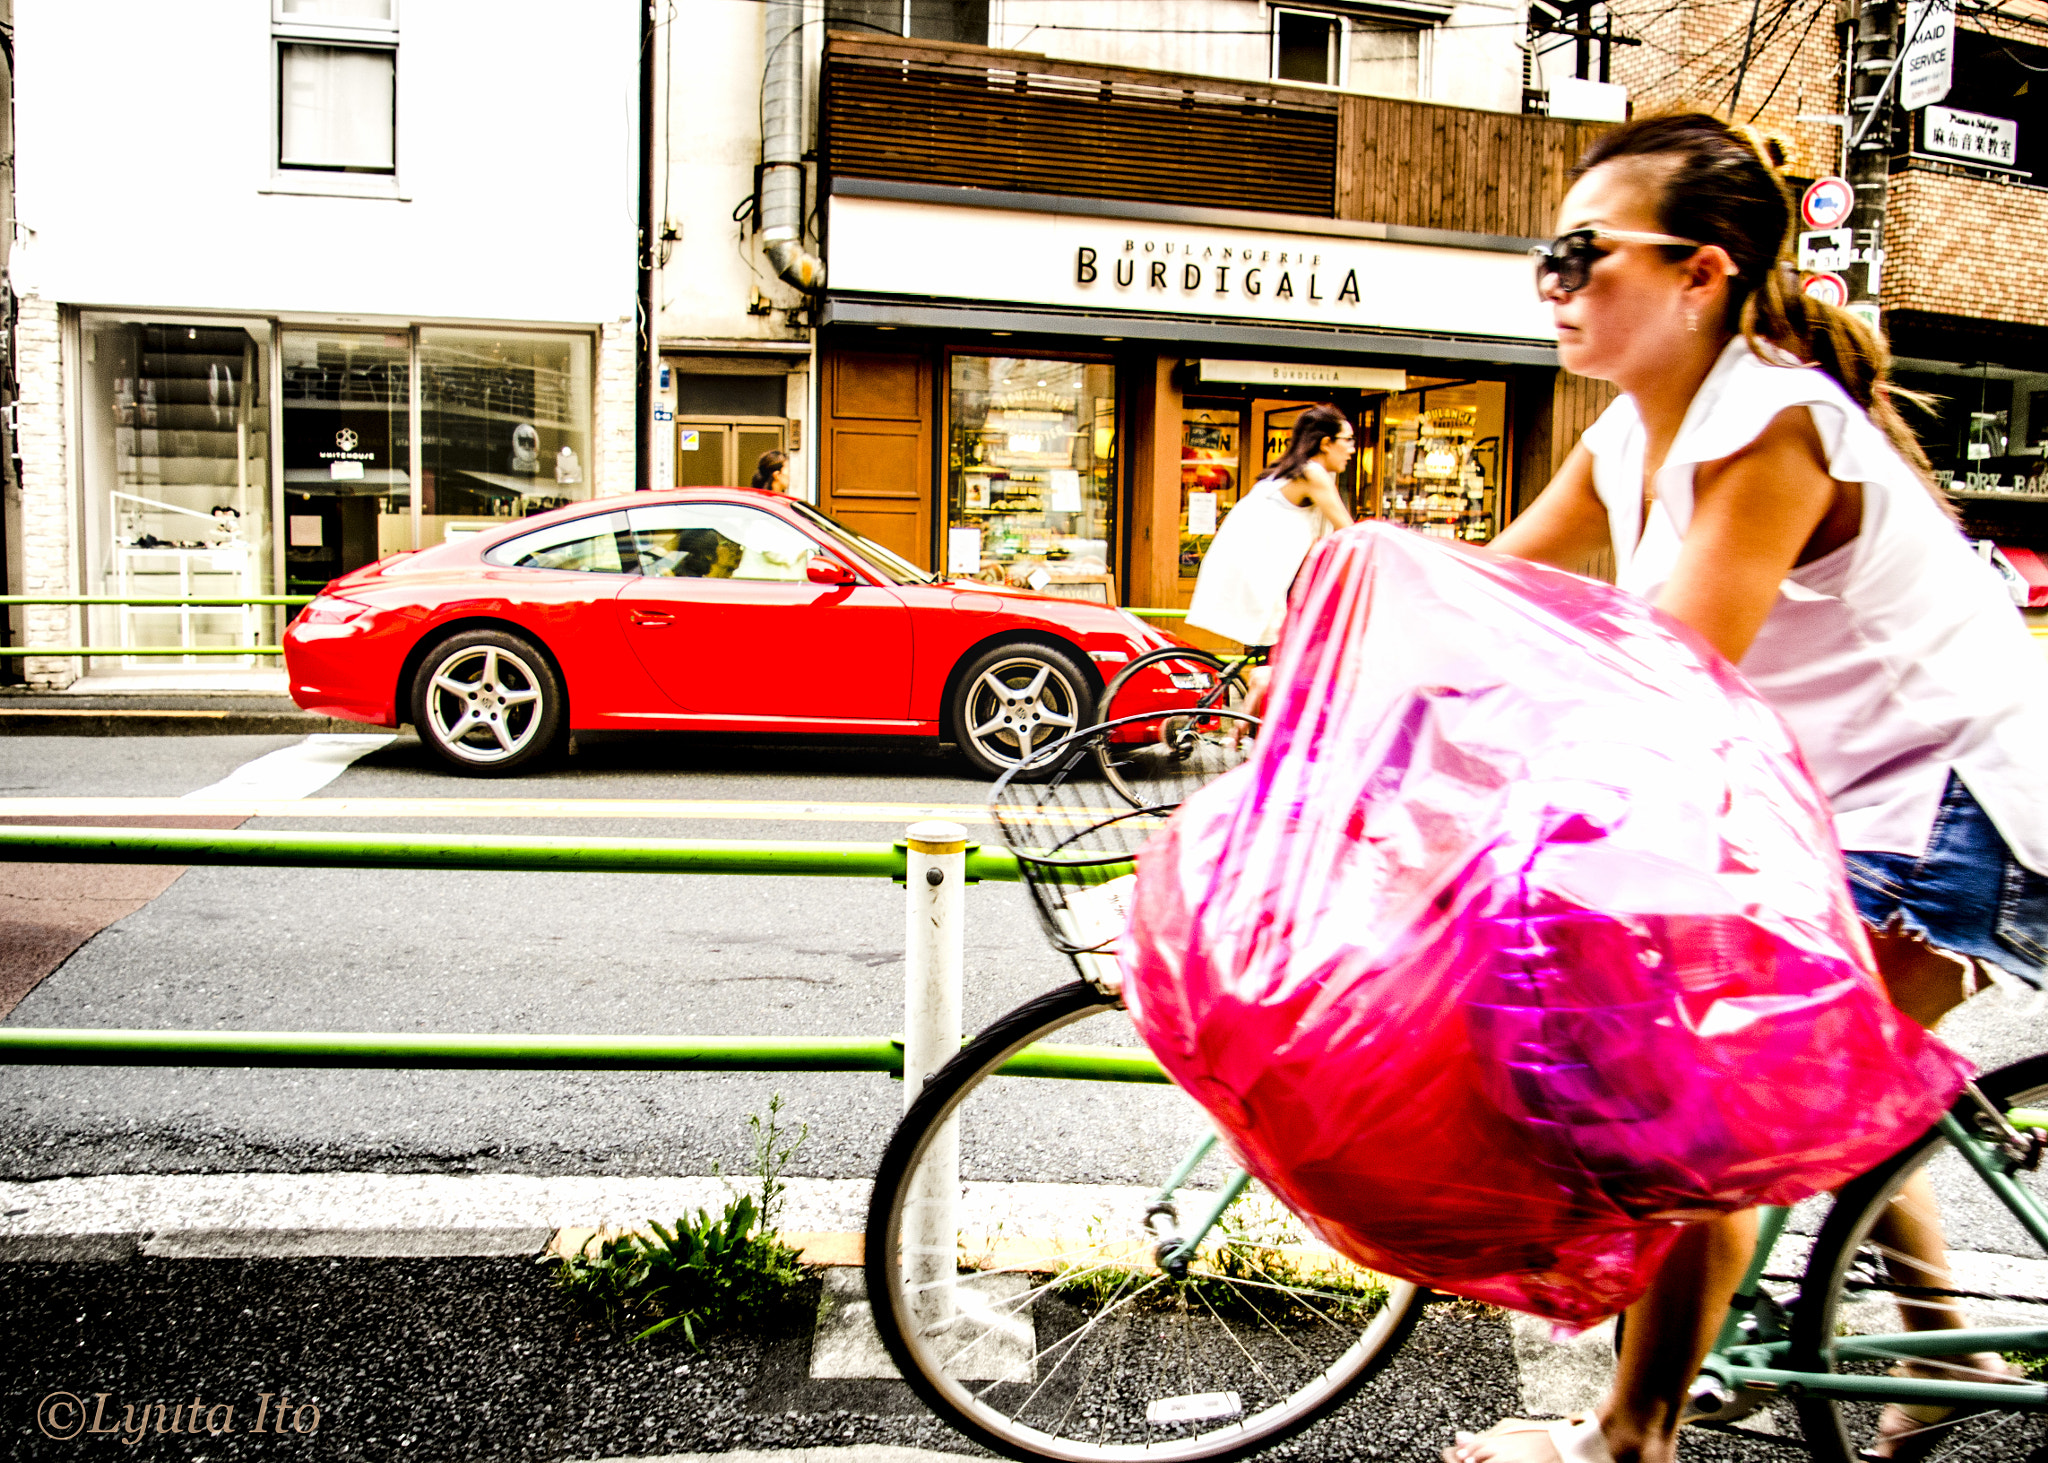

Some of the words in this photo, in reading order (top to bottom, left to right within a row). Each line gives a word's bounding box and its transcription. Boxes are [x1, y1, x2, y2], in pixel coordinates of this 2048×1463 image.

[1913, 25, 1945, 46] MAID
[1909, 48, 1947, 72] SERVICE
[1125, 239, 1322, 266] BOULANGERIE
[1077, 246, 1361, 303] BURDIGALA
[1273, 368, 1339, 381] BURDIGALA
[1966, 472, 2002, 491] DRY
[2014, 474, 2048, 494] BAR
